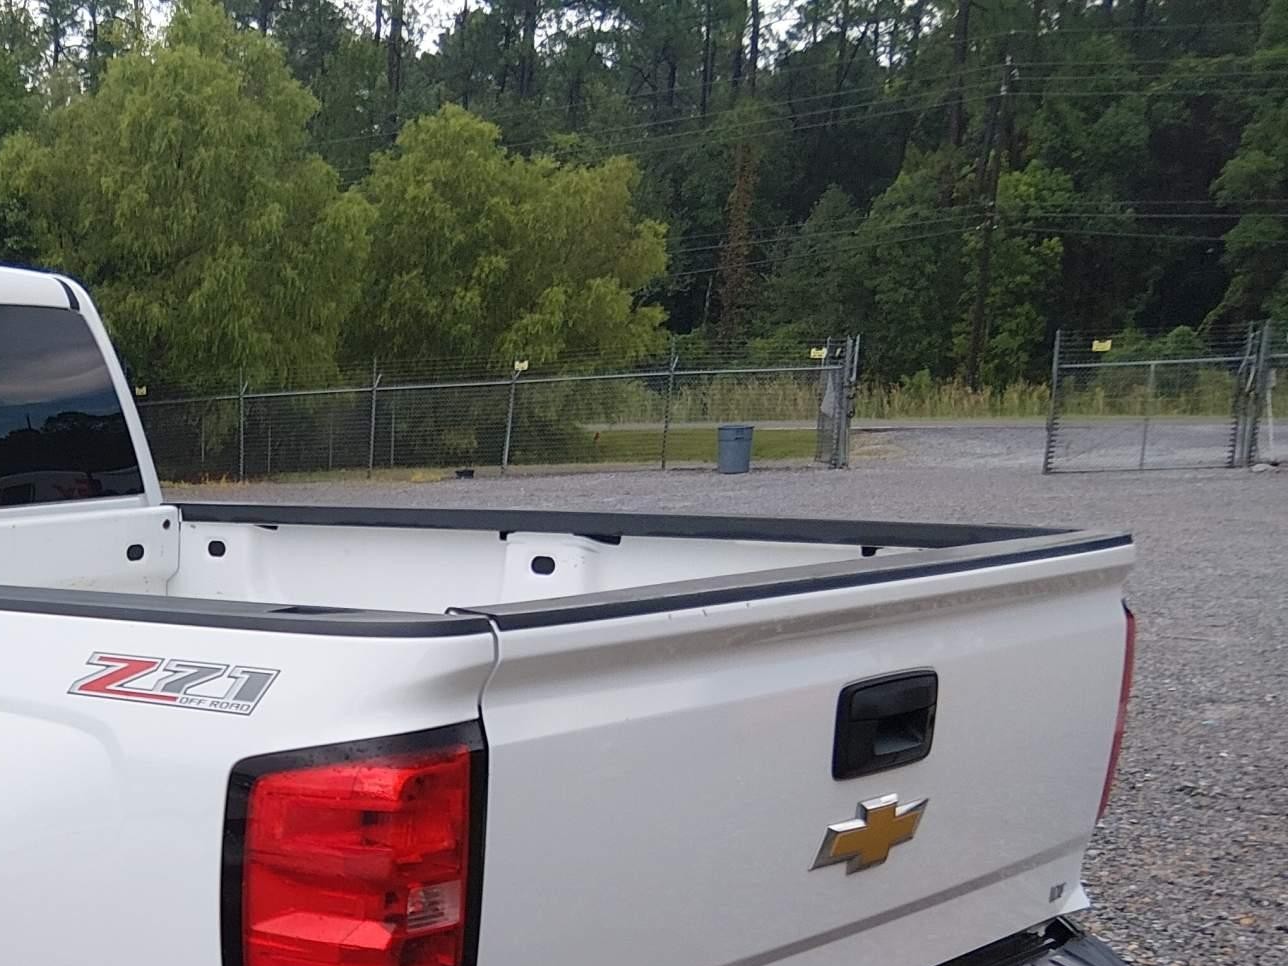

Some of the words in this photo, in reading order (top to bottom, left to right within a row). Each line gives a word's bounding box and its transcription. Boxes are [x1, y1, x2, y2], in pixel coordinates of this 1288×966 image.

[67, 651, 280, 714] Z71
[178, 697, 208, 707] OFF
[210, 700, 251, 712] ROAD
